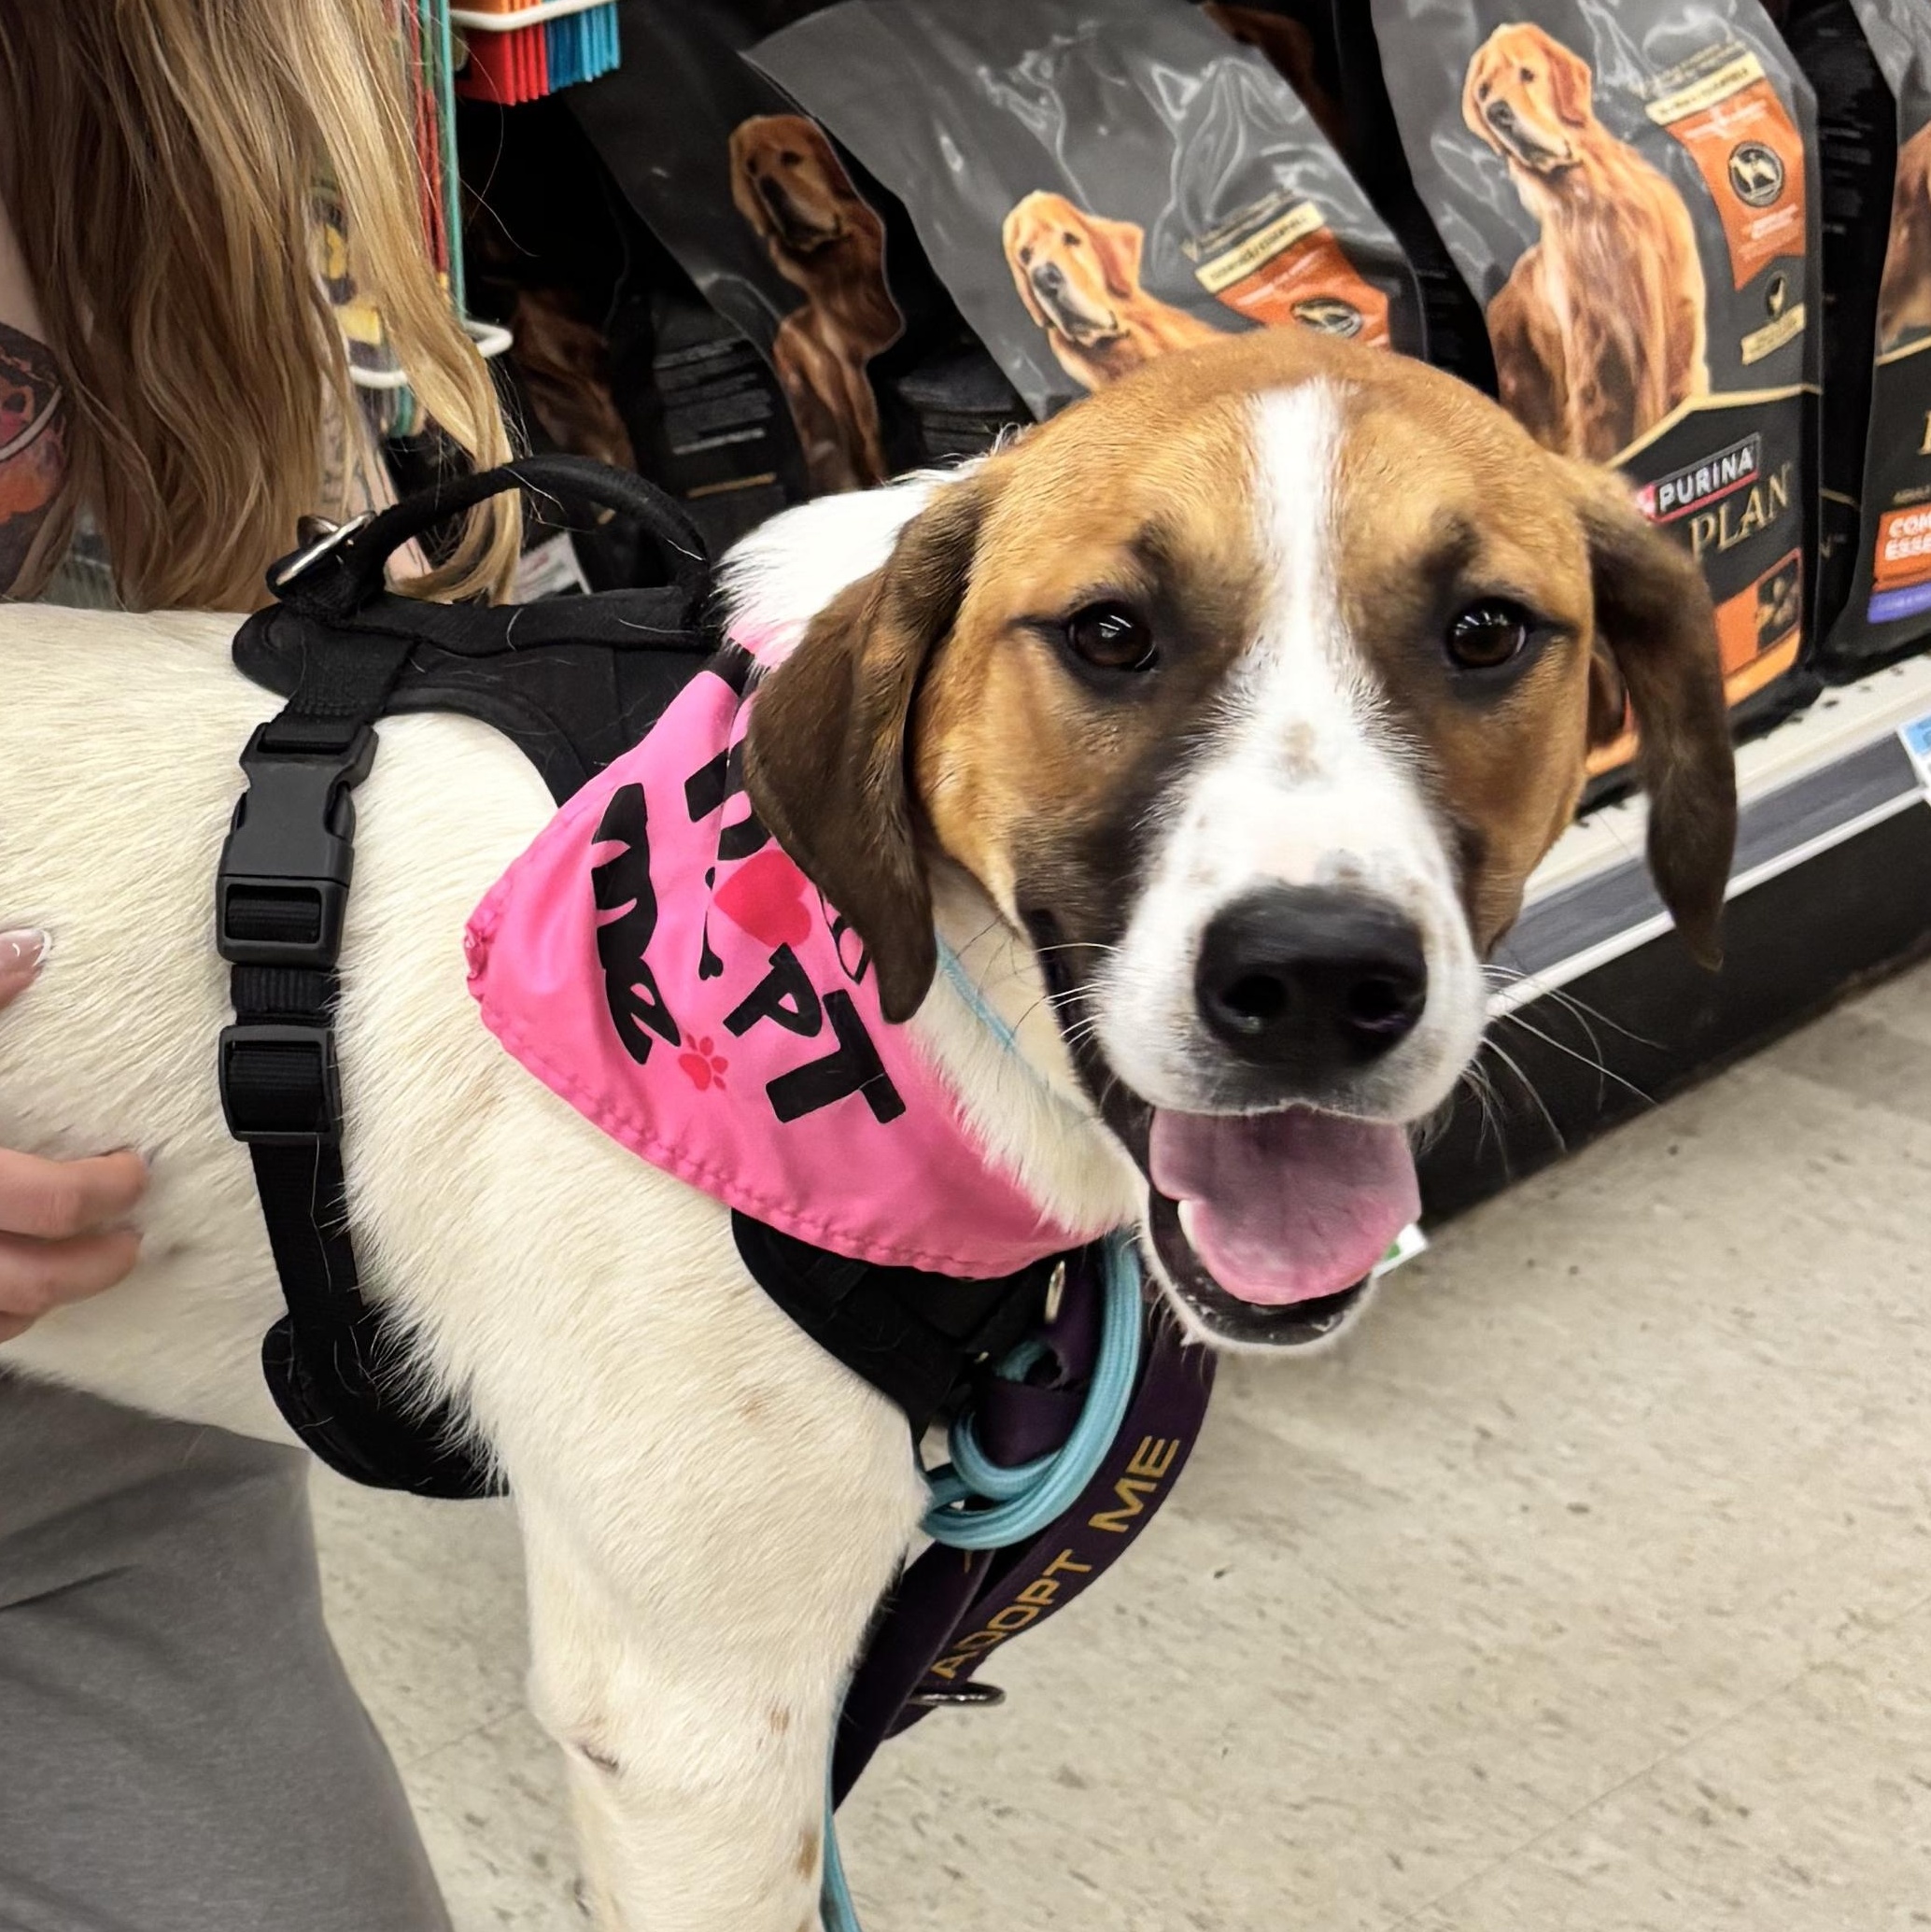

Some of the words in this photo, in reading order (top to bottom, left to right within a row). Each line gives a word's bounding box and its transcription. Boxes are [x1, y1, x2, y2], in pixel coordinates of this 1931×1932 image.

[1659, 445, 1755, 513] PURINA
[1689, 460, 1792, 561] PLAN
[930, 1548, 1092, 1680] ADOPT
[1088, 1435, 1179, 1532] ME
